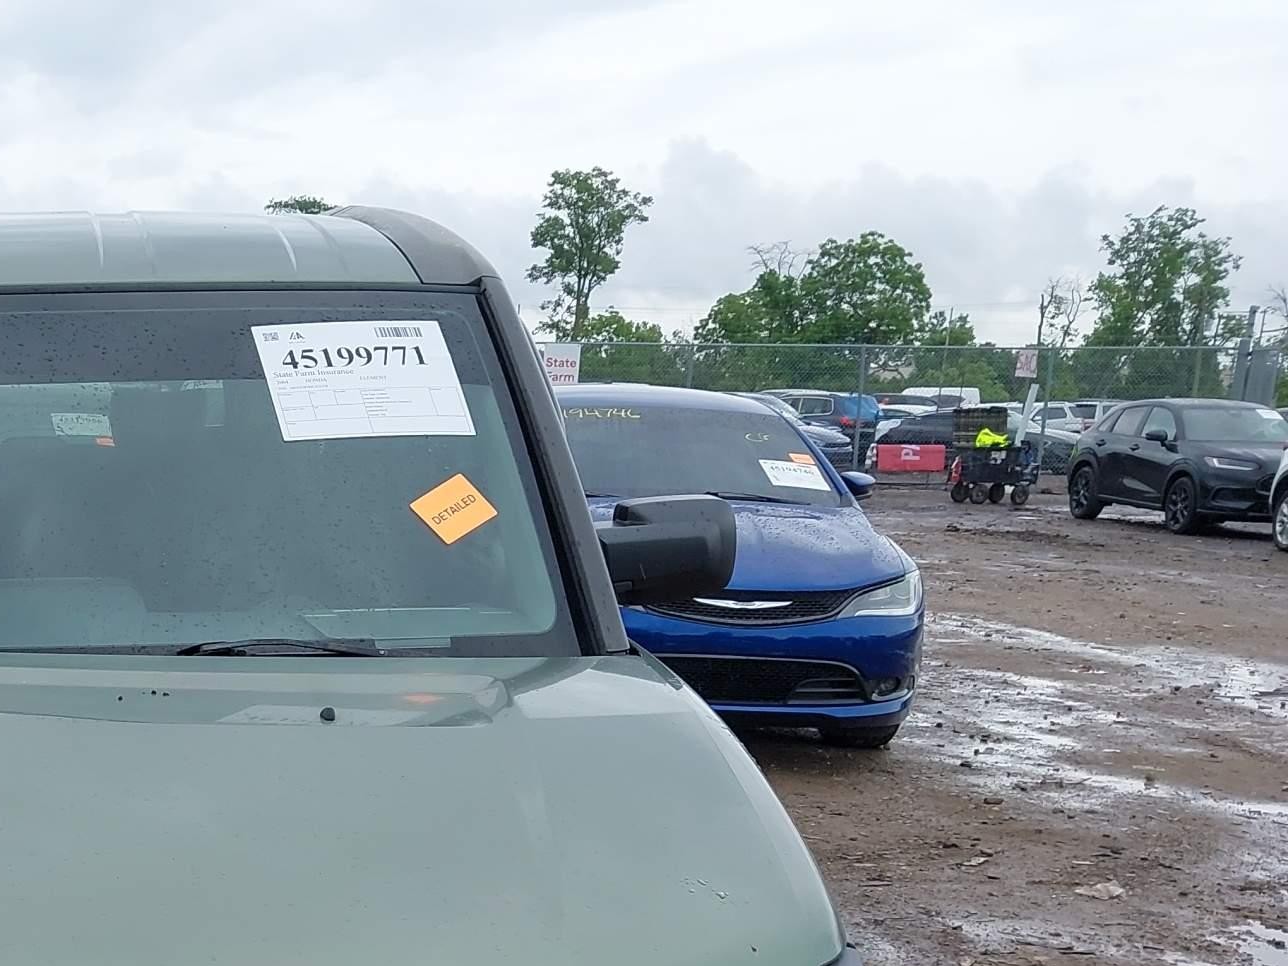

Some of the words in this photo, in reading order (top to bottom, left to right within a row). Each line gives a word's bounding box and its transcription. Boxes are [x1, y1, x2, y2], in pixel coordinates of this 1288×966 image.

[282, 345, 429, 370] 45199771
[546, 357, 577, 369] State
[272, 371, 294, 379] State
[294, 370, 316, 378] Farm
[317, 368, 355, 377] Insurance
[432, 494, 477, 525] DETAILED
